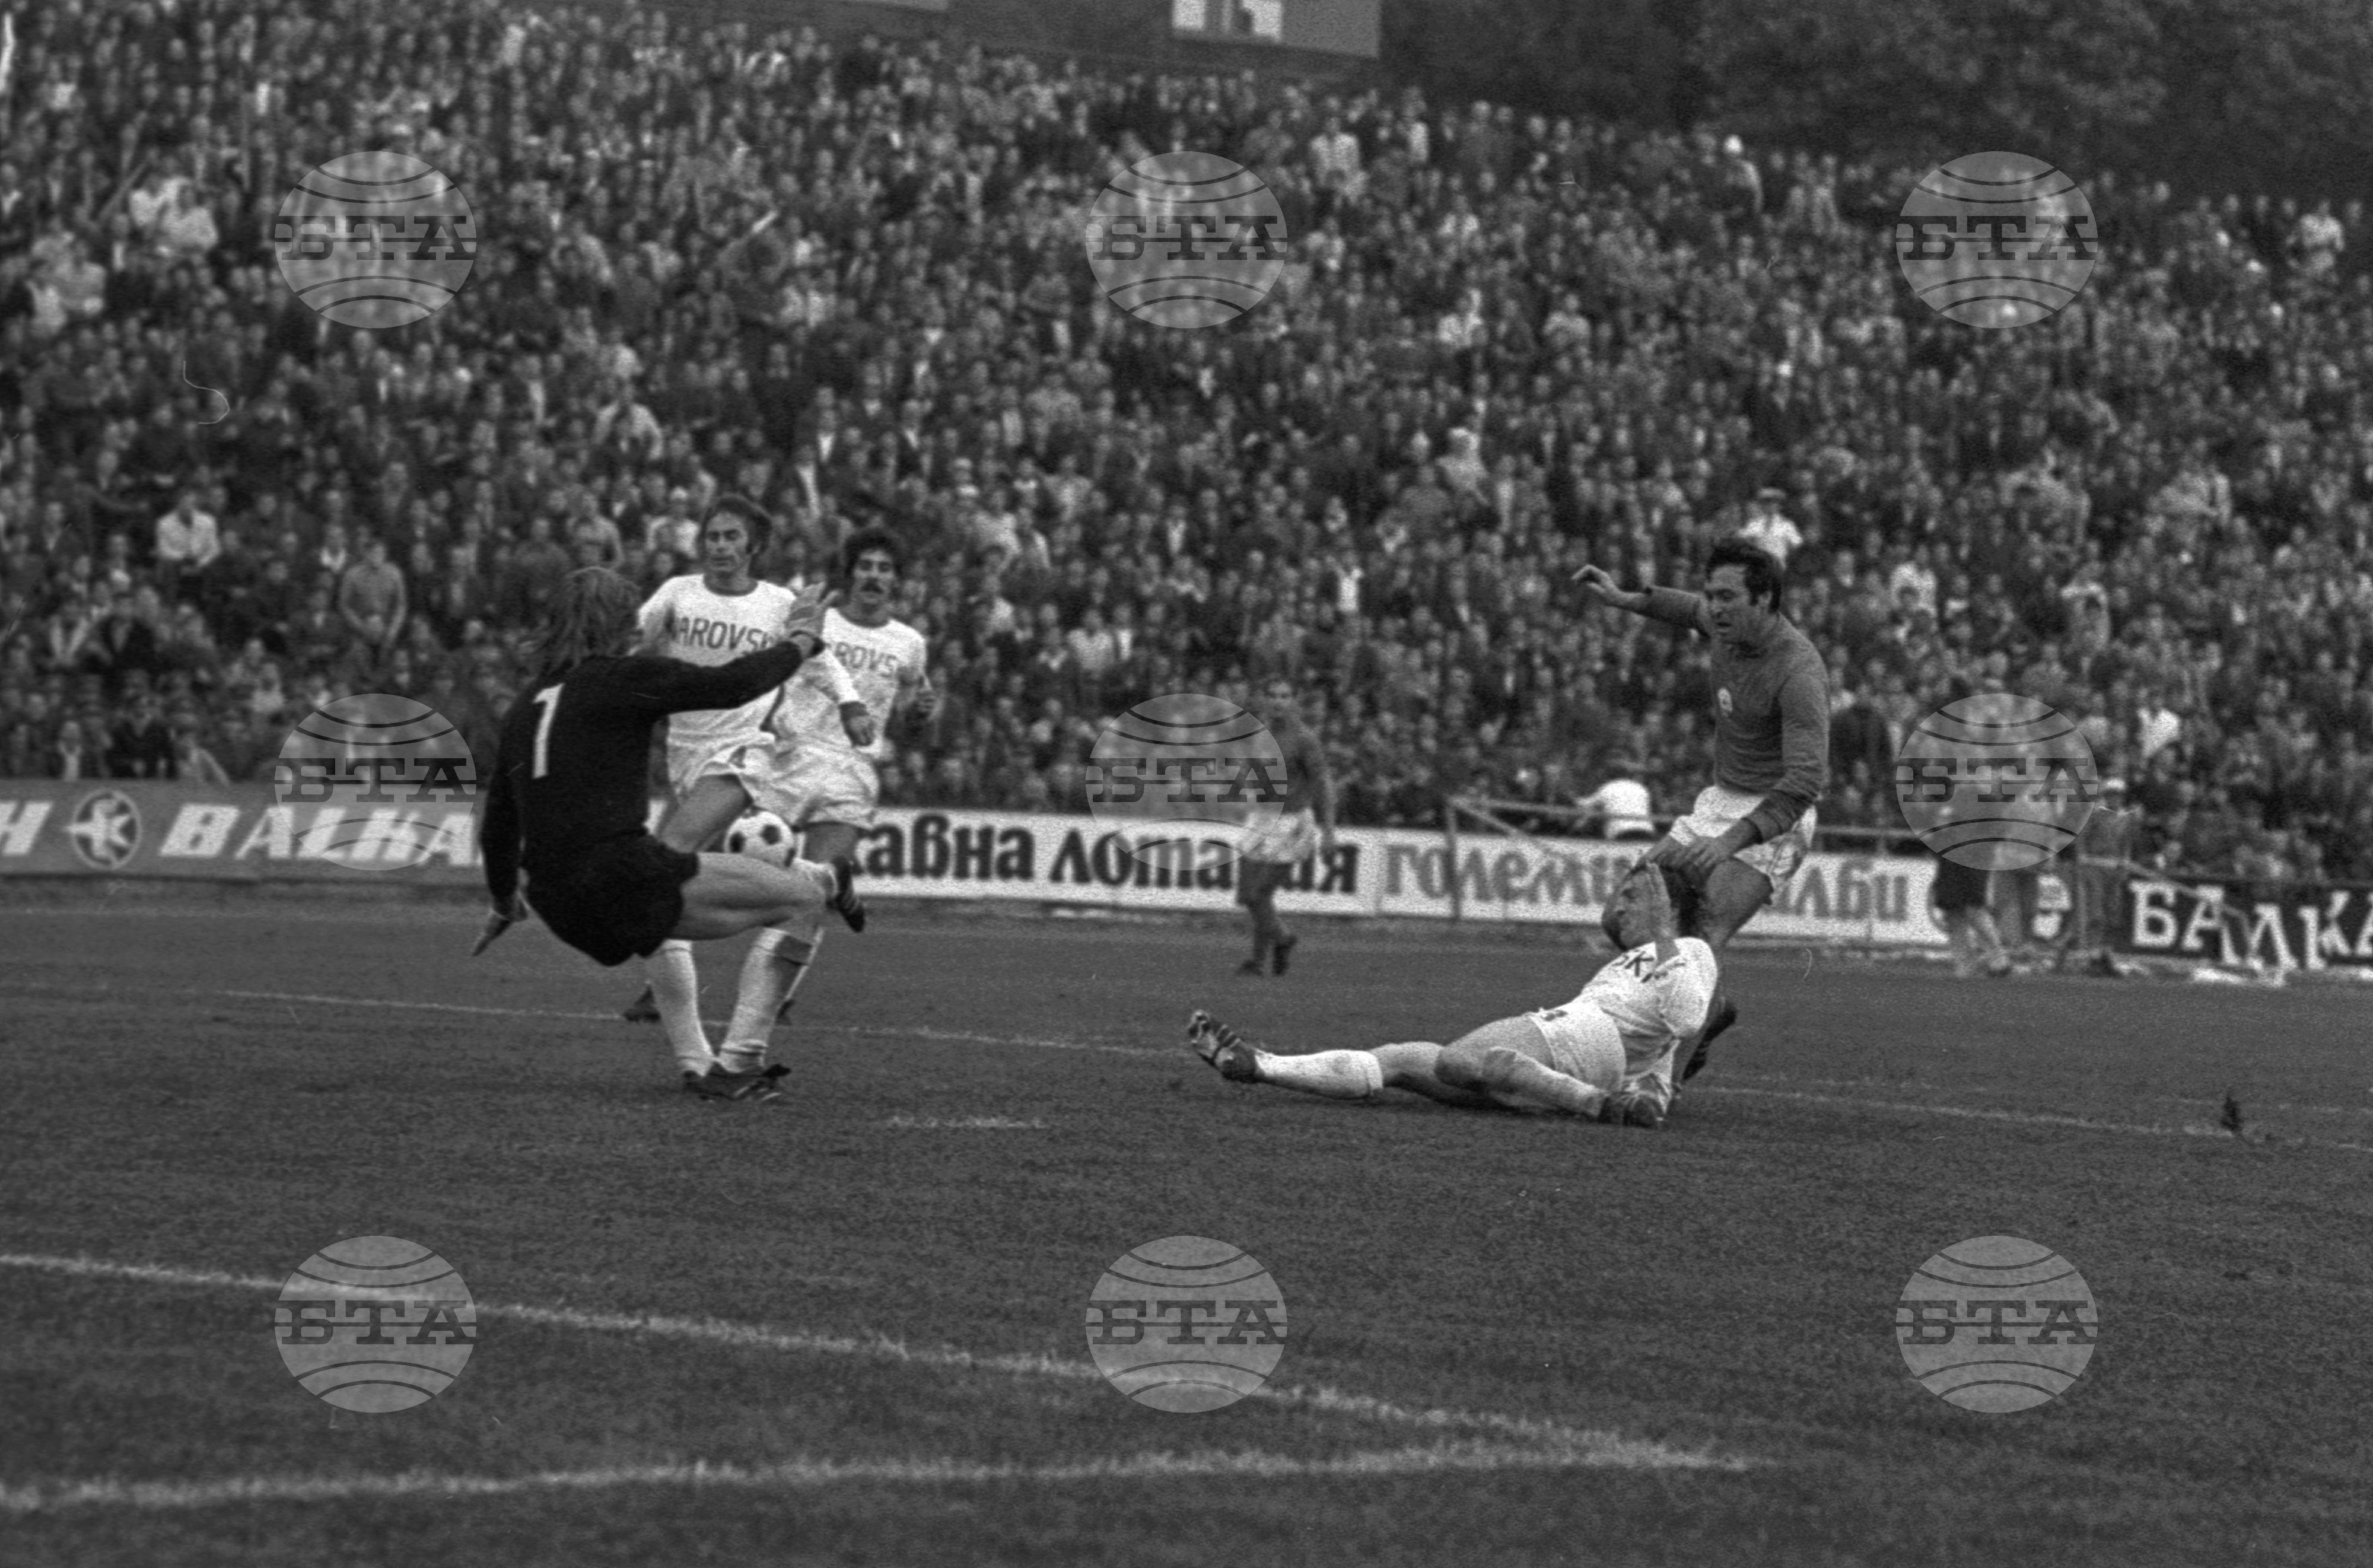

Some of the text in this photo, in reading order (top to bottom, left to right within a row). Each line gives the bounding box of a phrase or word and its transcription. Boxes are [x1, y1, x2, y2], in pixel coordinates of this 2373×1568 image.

[533, 683, 564, 779] 1
[158, 803, 483, 866] BALKA
[853, 815, 1360, 895] авна лотаия
